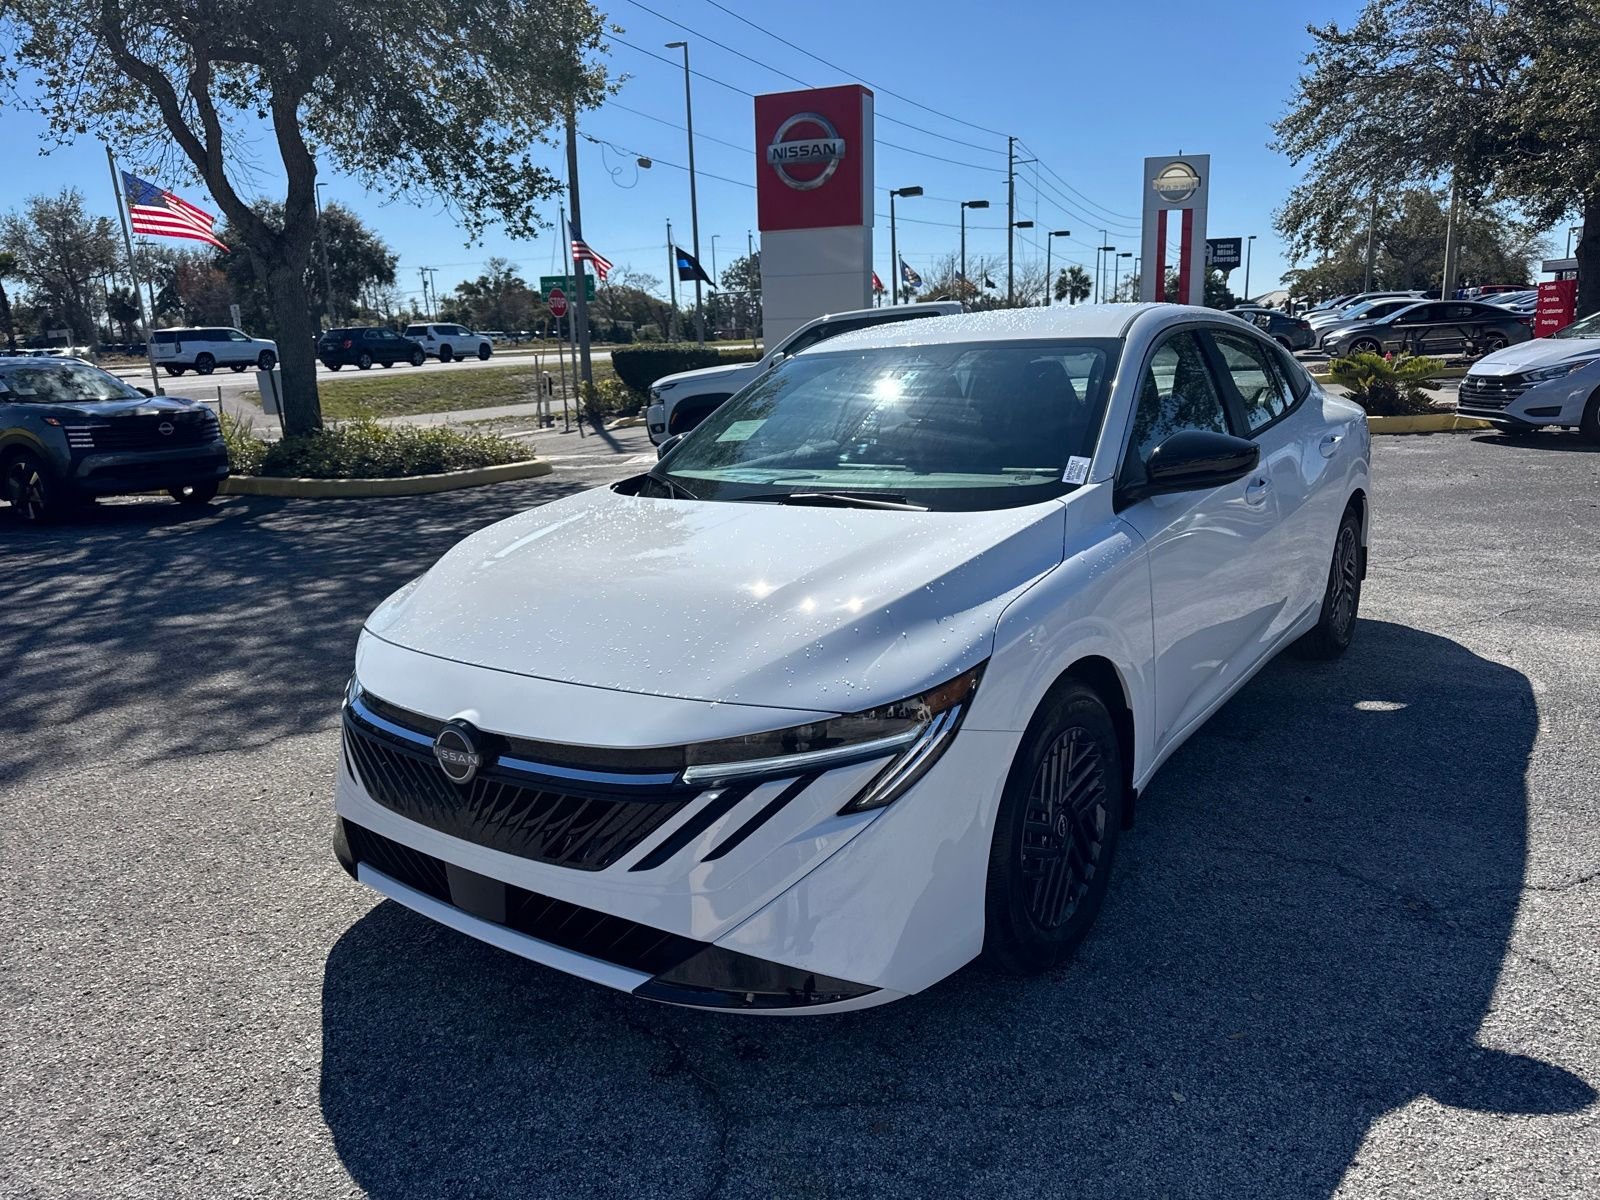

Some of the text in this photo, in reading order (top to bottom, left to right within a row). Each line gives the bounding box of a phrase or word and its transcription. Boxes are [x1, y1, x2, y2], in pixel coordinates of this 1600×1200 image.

[772, 143, 837, 160] NISSAN
[1213, 255, 1239, 263] Storage
[550, 297, 565, 309] STOP
